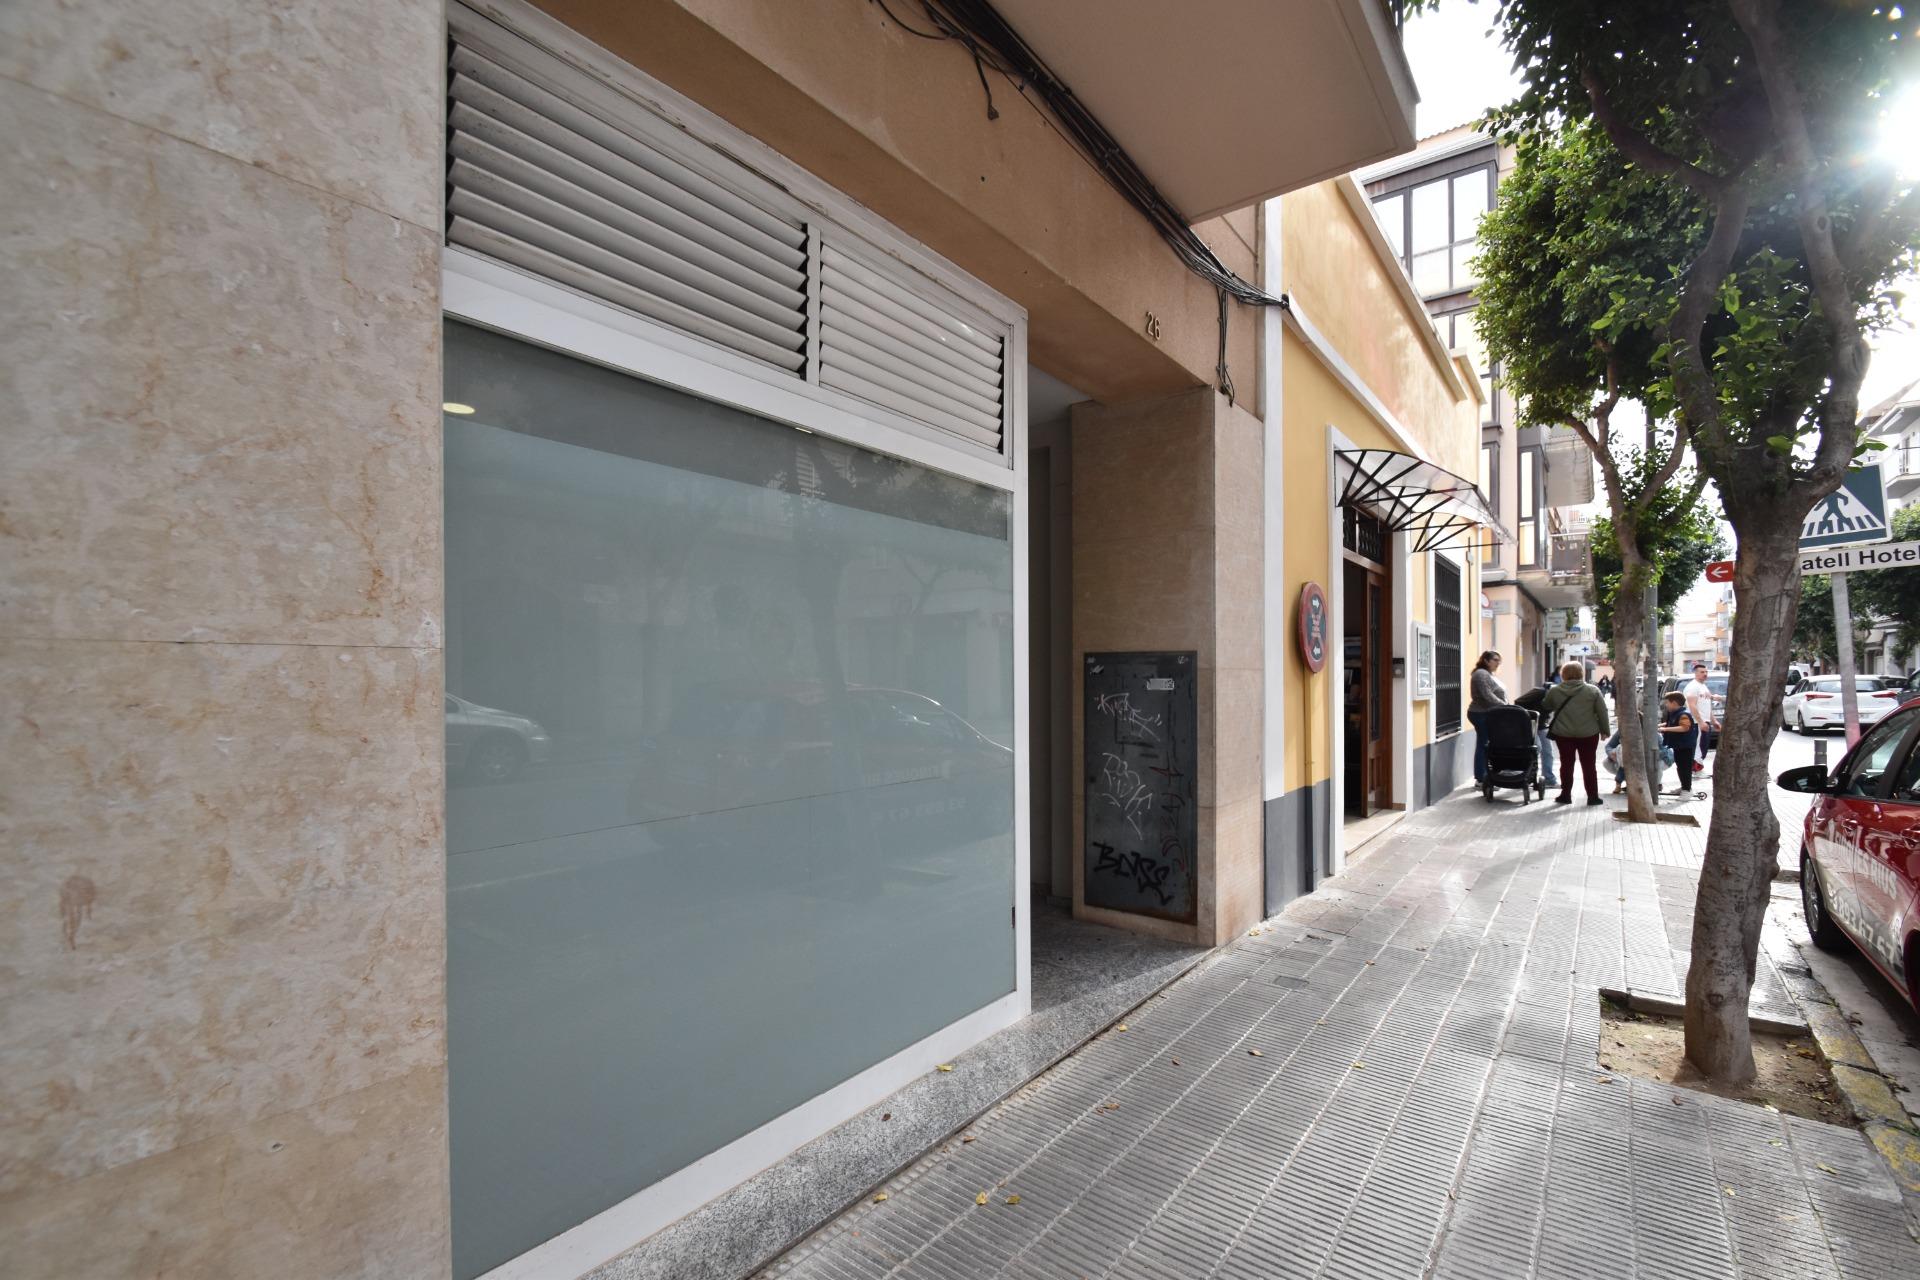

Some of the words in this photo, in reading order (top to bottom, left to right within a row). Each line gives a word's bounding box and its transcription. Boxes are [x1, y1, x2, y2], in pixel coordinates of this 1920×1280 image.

[1145, 311, 1161, 340] 26
[1802, 552, 1850, 570] atell
[1871, 857, 1897, 900] RIUS
